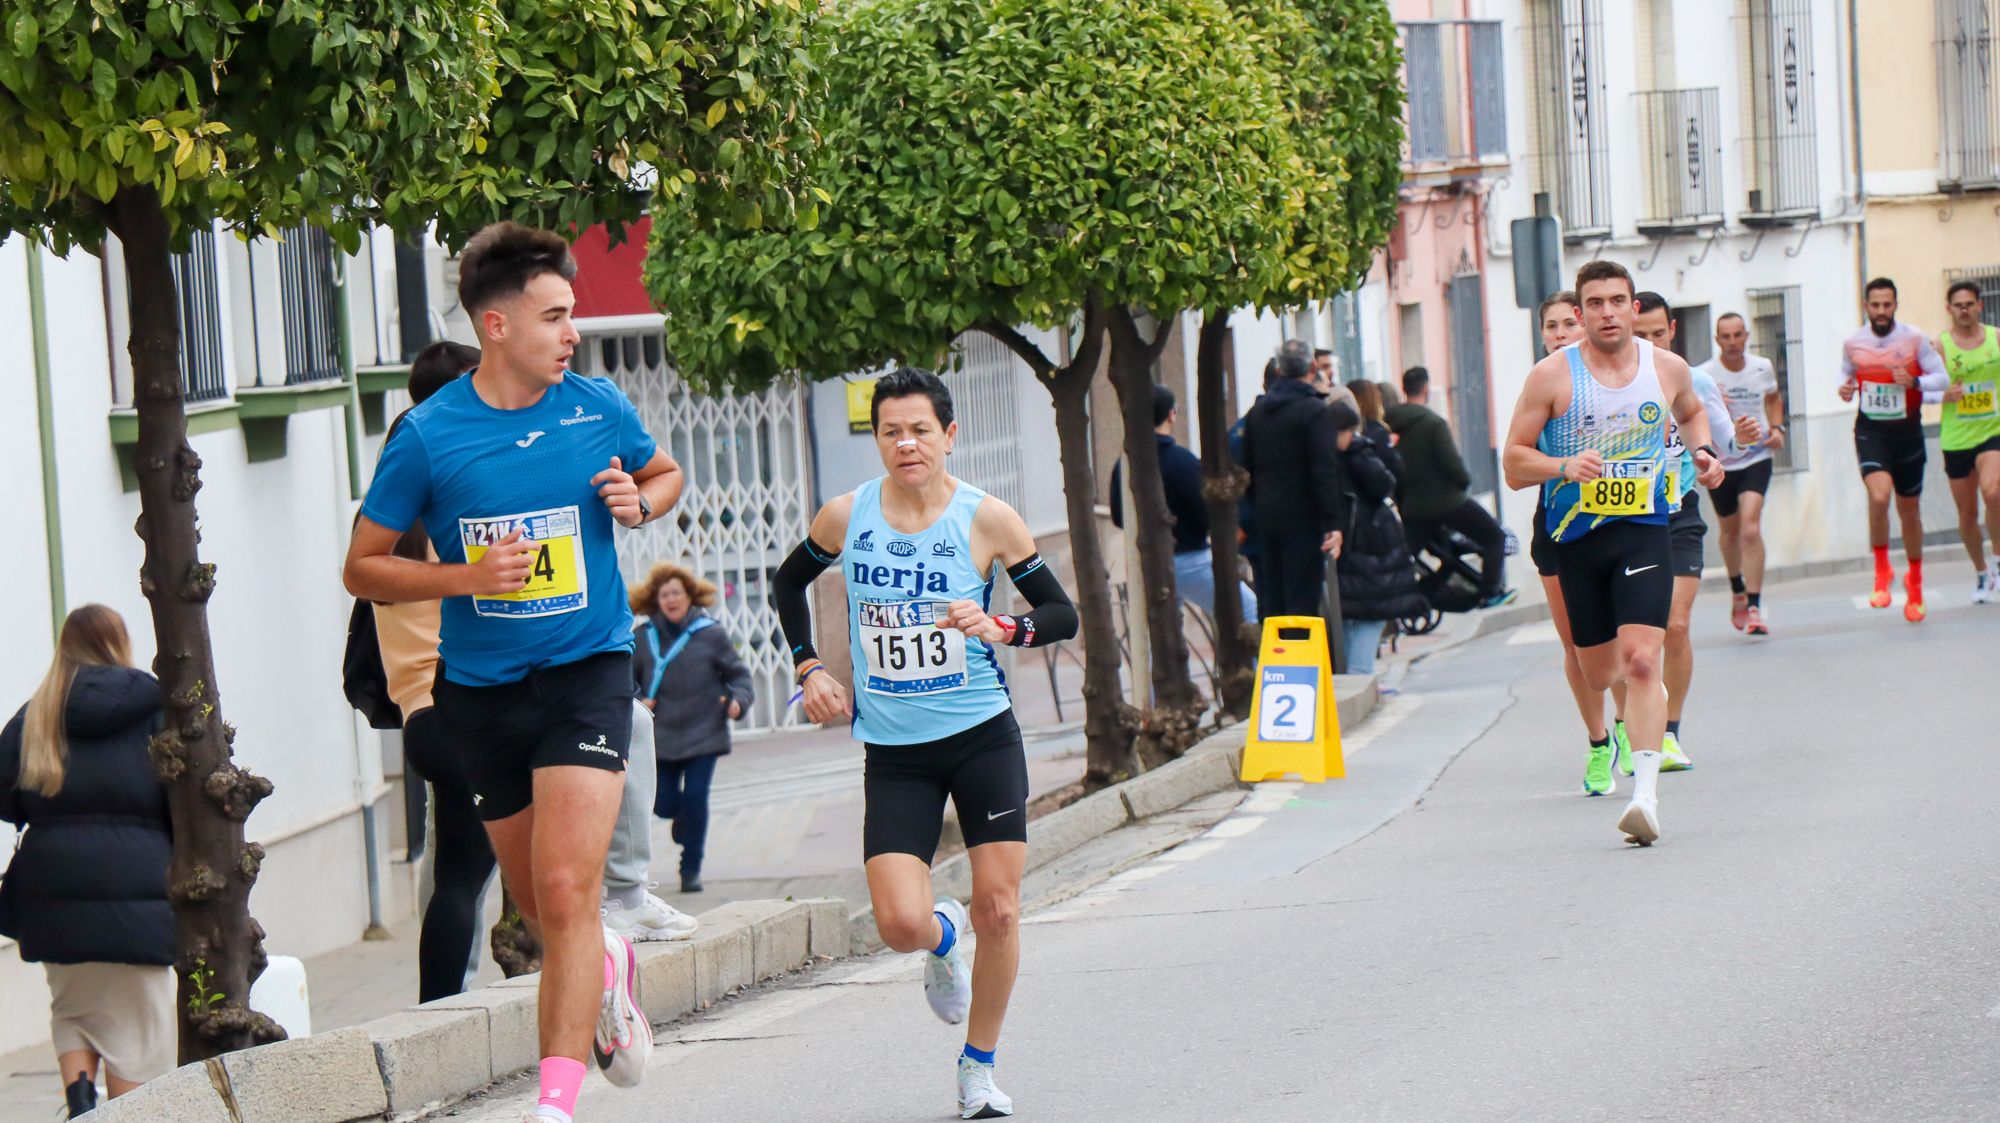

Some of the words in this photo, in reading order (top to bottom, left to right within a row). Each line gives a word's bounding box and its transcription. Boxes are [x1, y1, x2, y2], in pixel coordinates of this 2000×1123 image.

[1868, 394, 1898, 408] 1461
[560, 414, 603, 426] OpenArena
[1595, 480, 1636, 506] 898
[887, 543, 916, 556] TROPS
[931, 539, 956, 557] als
[852, 561, 950, 597] nerja
[868, 605, 900, 628] 21K
[872, 630, 948, 670] 1513
[1264, 671, 1285, 682] km
[1272, 694, 1297, 727] 2
[578, 742, 619, 758] OpenArena
